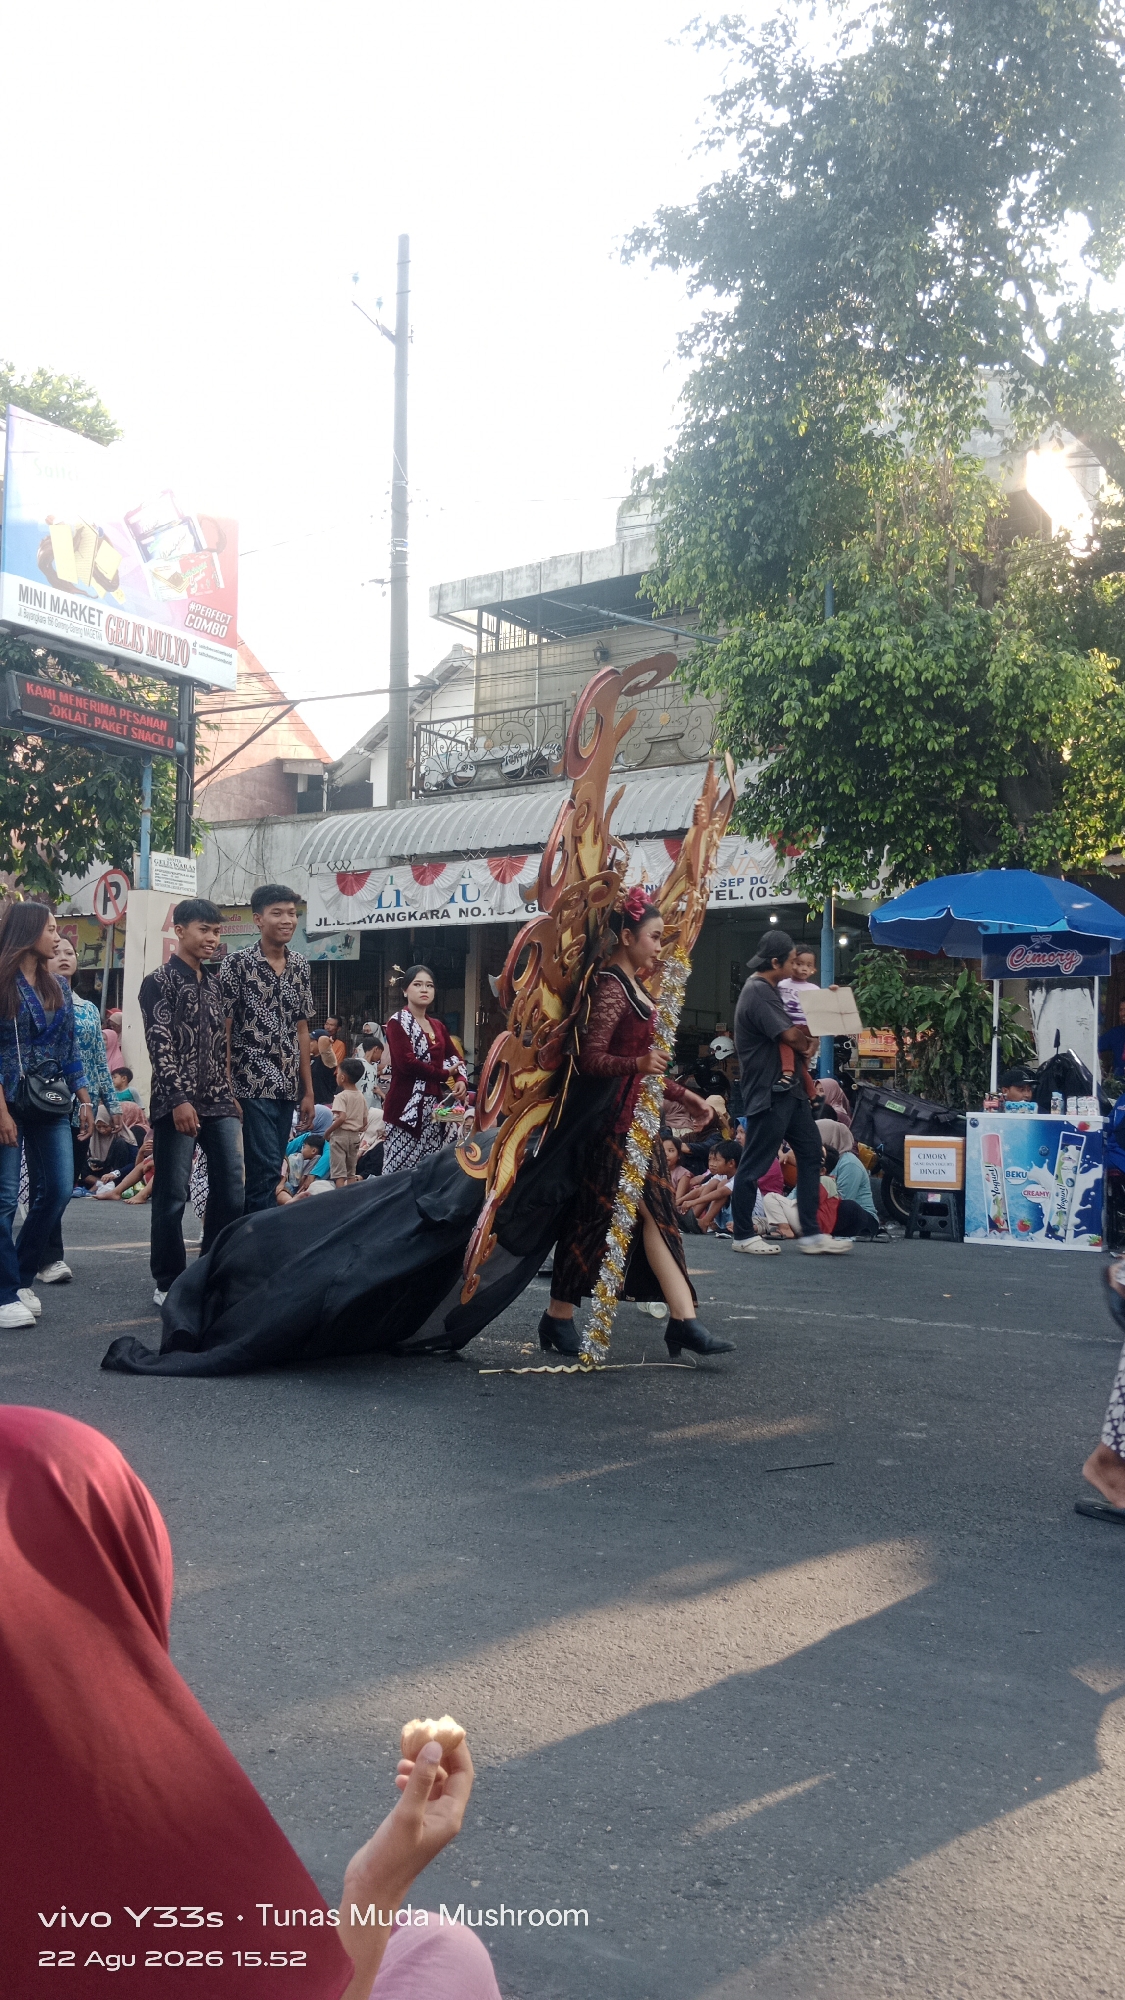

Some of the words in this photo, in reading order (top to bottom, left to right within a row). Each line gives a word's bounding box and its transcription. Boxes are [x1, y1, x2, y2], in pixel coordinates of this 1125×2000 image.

[19, 583, 47, 610] MINI
[50, 594, 104, 627] MARKET
[188, 601, 233, 625] #PERFECT
[105, 613, 145, 654] GELIS
[146, 626, 191, 668] MULYO
[185, 613, 229, 639] COMBO
[26, 681, 57, 701] KAMI
[59, 691, 117, 718] MENERIMA
[119, 708, 168, 732] PESANAN
[94, 716, 129, 737] PAKET
[130, 726, 165, 746] SNACK
[102, 880, 122, 916] P
[1007, 944, 1082, 974] Cimory
[1005, 1170, 1028, 1179] BEKU
[1022, 1190, 1050, 1198] CREAMY
